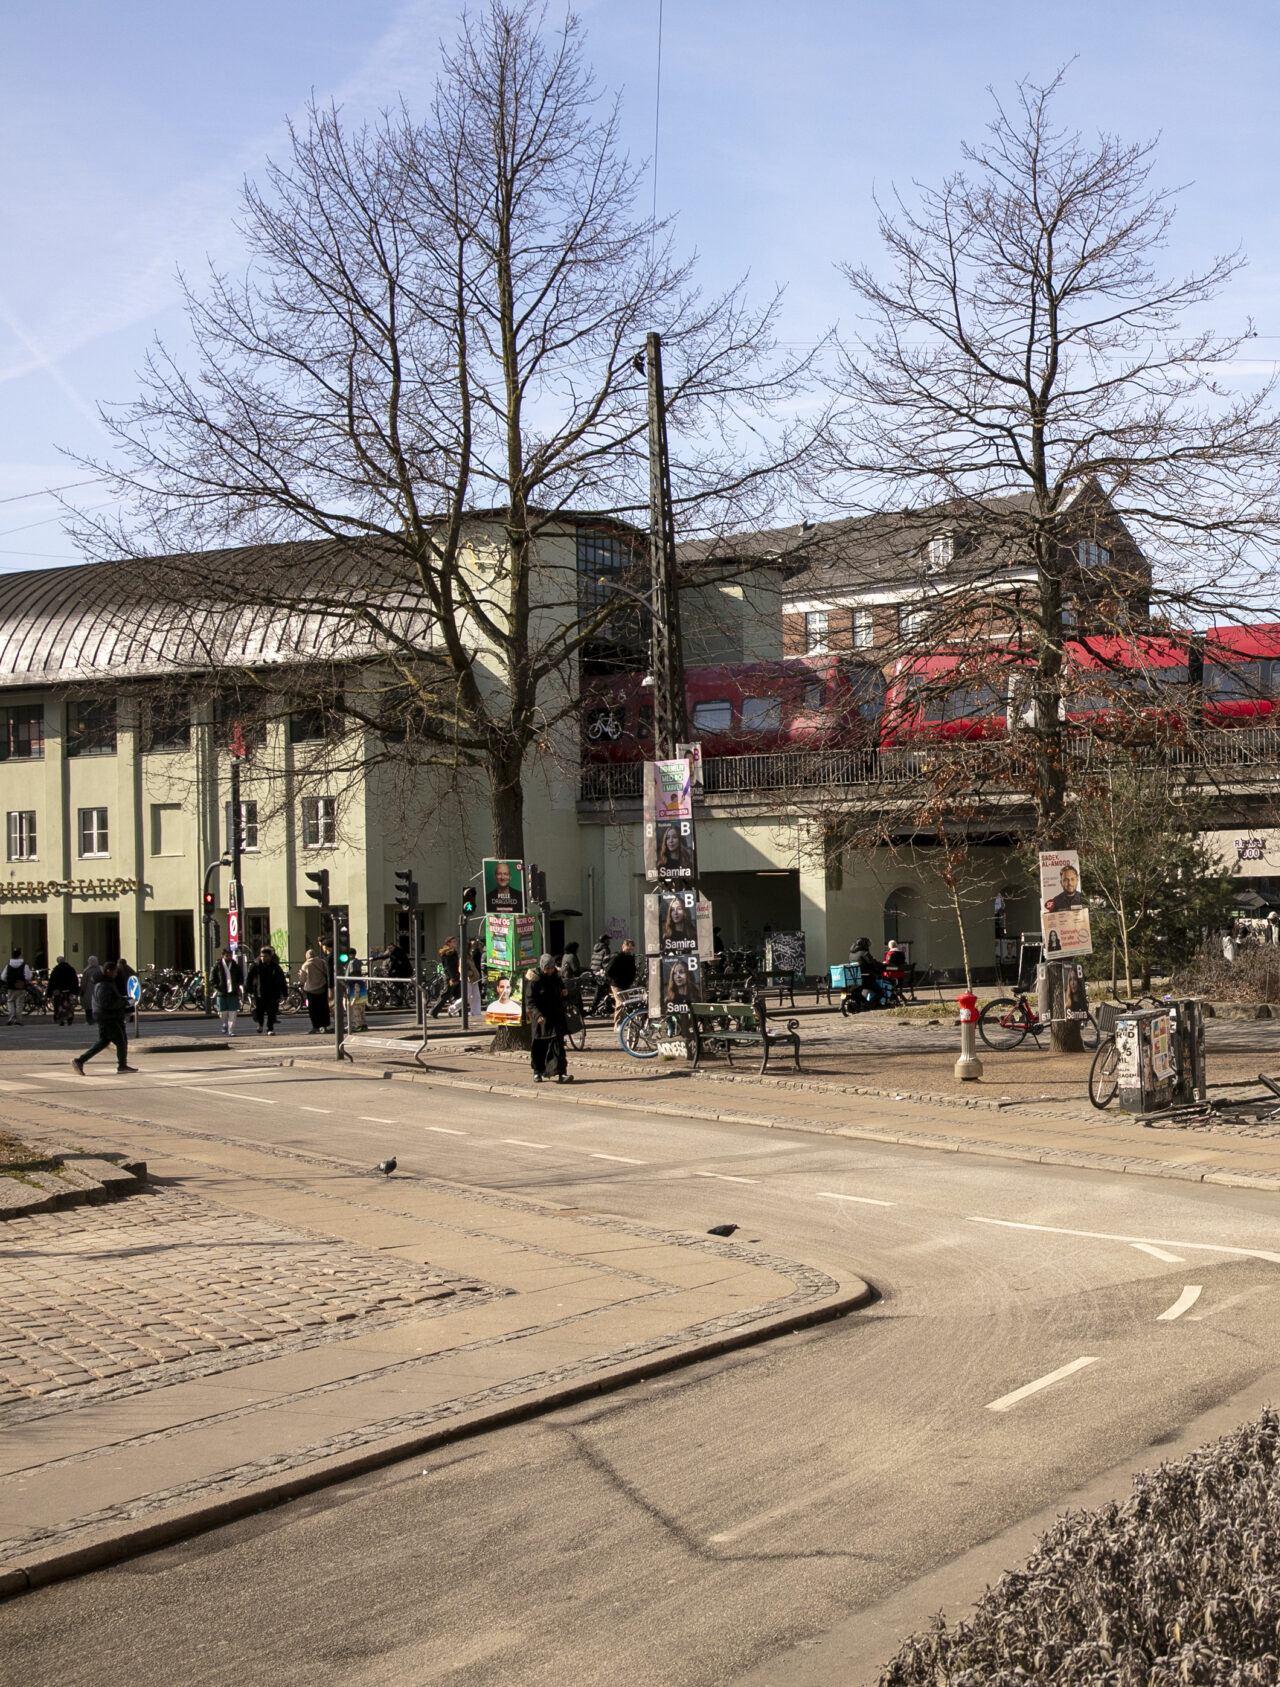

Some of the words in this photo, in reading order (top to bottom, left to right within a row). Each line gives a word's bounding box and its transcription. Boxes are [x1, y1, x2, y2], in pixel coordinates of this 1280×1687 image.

[681, 822, 691, 836] B
[660, 866, 692, 878] Samira
[66, 877, 139, 894] STATION
[684, 893, 695, 908] B
[1046, 901, 1054, 909] SF
[501, 917, 510, 926] OG
[527, 915, 536, 924] OG
[664, 937, 697, 950] Samira
[687, 956, 698, 971] B
[1076, 964, 1083, 979] B
[1066, 1008, 1088, 1020] Samira
[1116, 1031, 1135, 1039] RD
